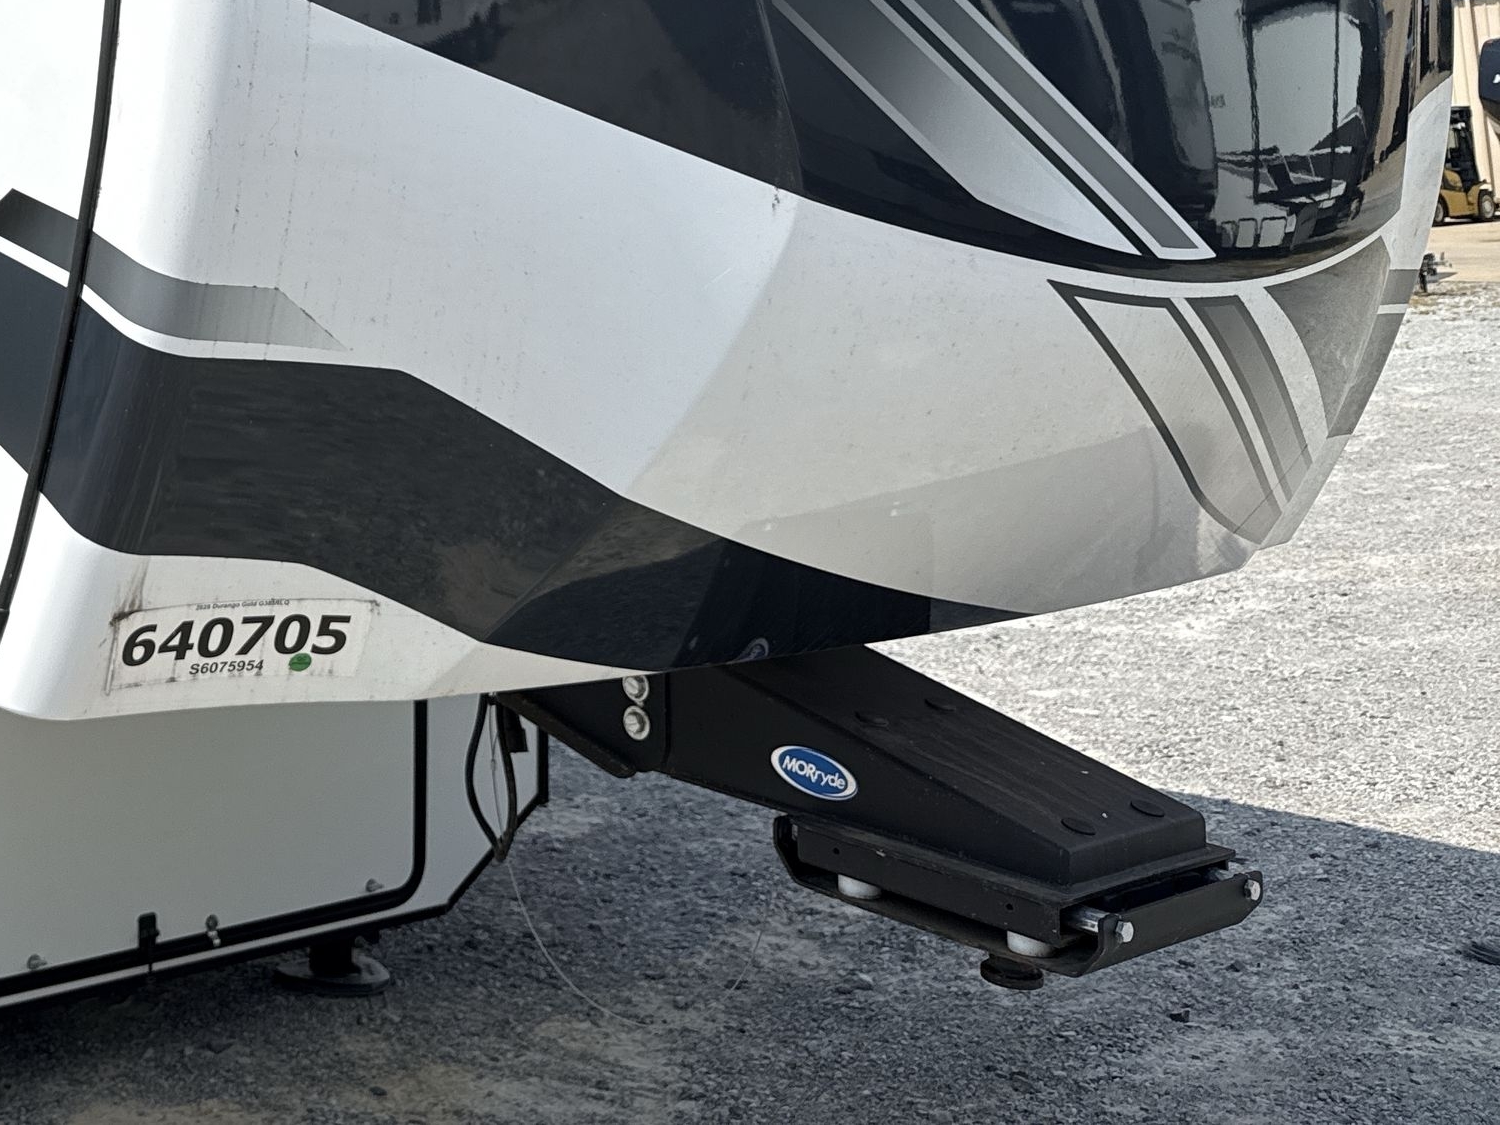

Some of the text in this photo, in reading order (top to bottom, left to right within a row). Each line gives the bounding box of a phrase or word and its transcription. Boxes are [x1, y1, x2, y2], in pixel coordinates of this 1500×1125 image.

[121, 613, 351, 667] 640705
[189, 659, 264, 675] S6075954
[782, 755, 846, 789] MORryde
